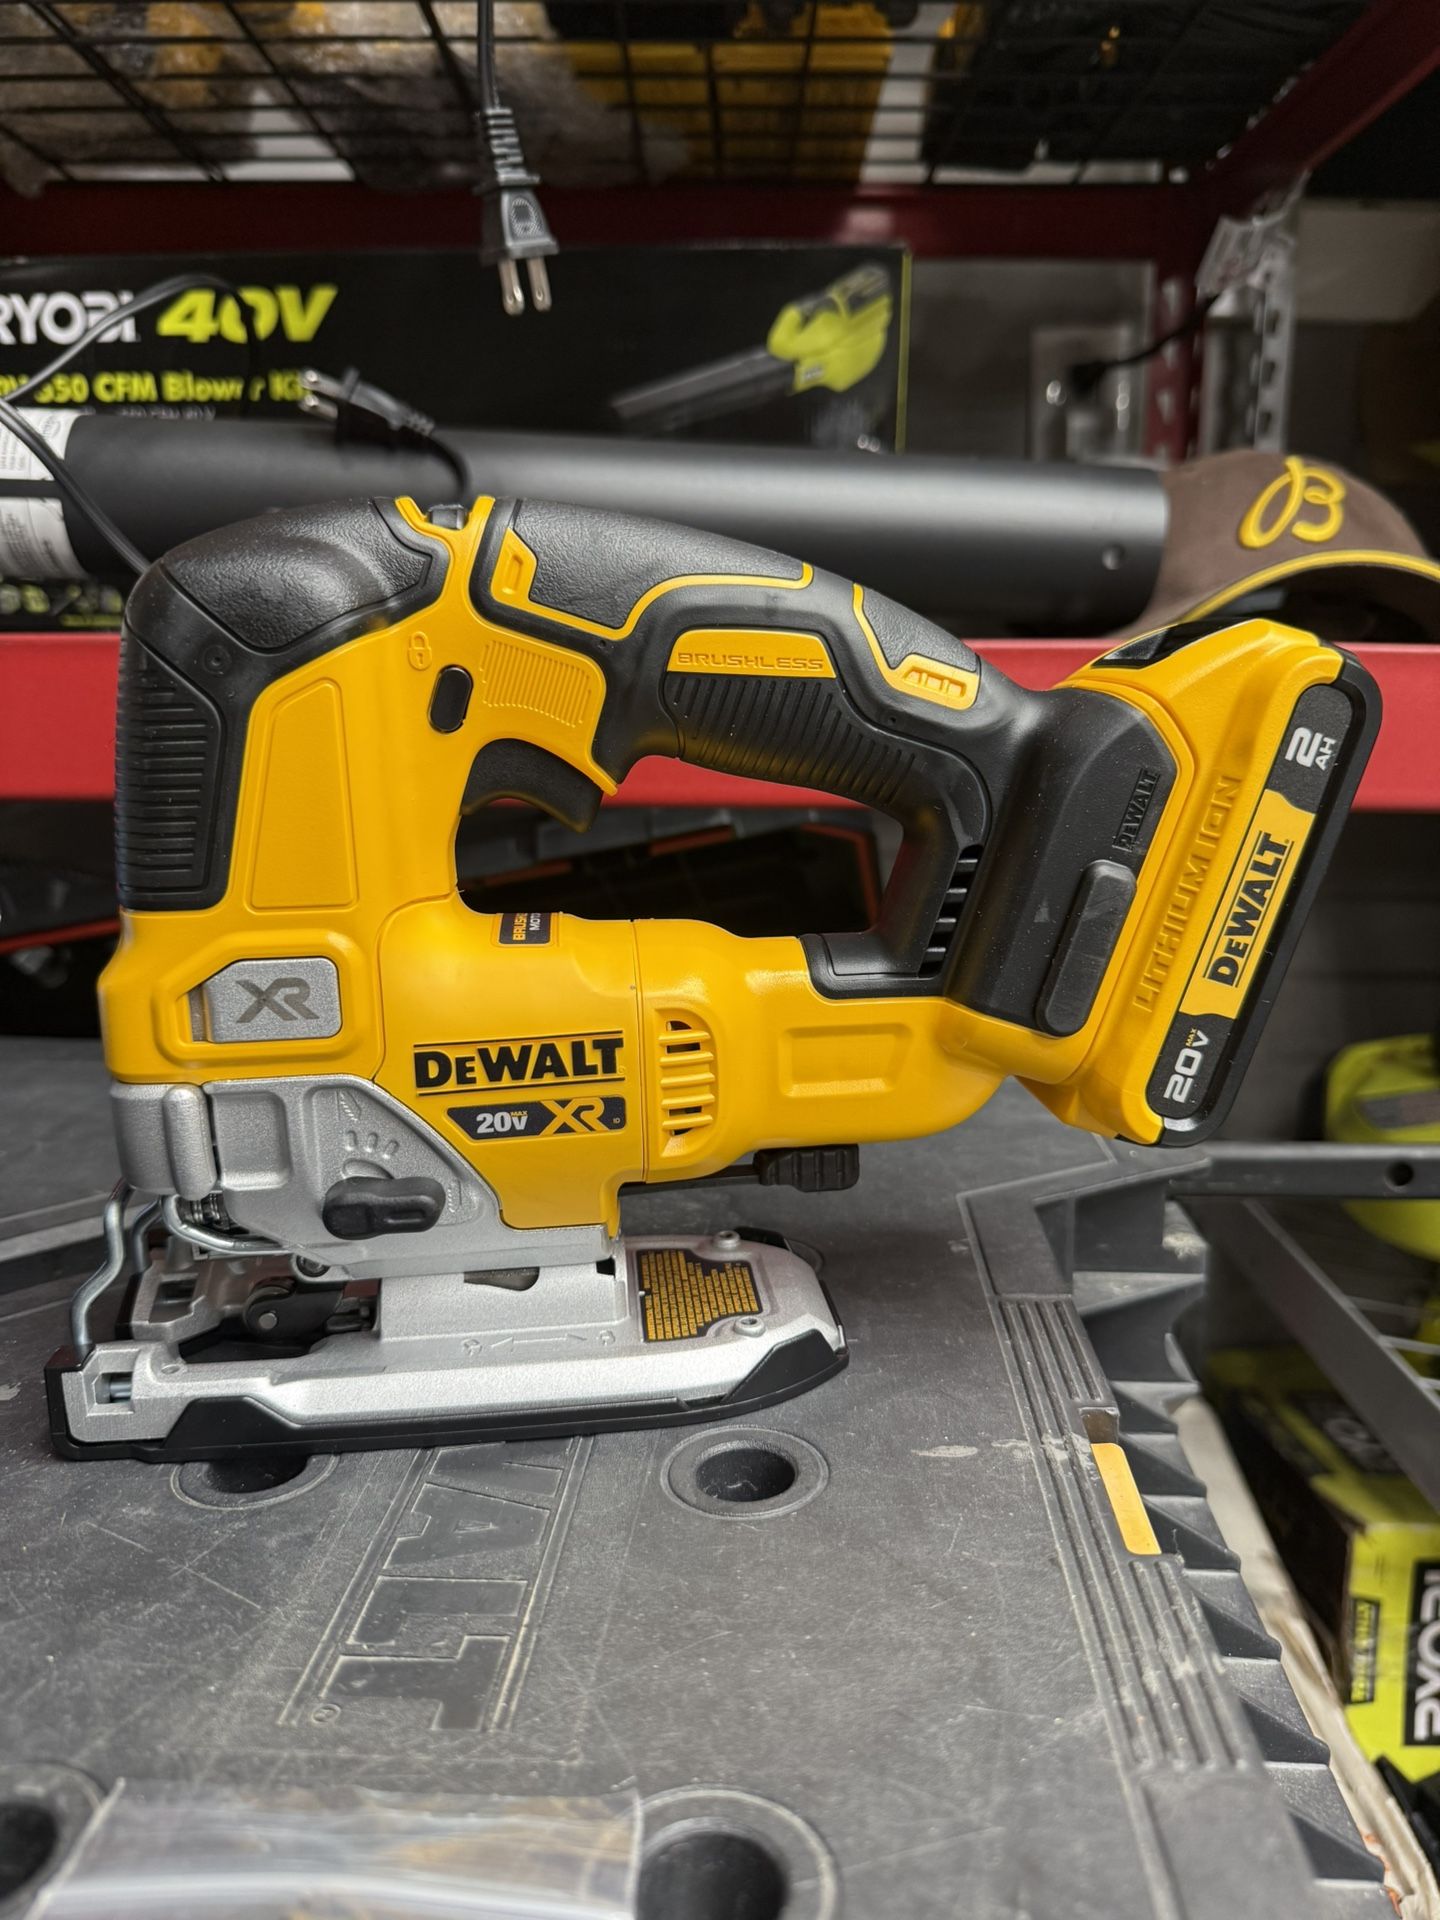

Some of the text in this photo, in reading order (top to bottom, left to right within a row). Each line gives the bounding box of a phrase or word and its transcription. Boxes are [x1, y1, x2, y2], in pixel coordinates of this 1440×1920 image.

[157, 284, 339, 343] 40V
[93, 371, 158, 403] CFM
[162, 369, 265, 402] Blowr
[677, 652, 824, 671] BRUSHLESS
[1285, 727, 1323, 767] 2
[1315, 736, 1337, 770] AH
[1115, 770, 1158, 852] DEWALT
[1132, 775, 1242, 1013] LITHIUM ION
[1207, 832, 1288, 987] DEWALT
[235, 978, 320, 1023] XR
[413, 1037, 624, 1089] DEWALT
[1163, 1029, 1209, 1103] 20V
[476, 1111, 528, 1134] 20V
[540, 1097, 610, 1135] XR
